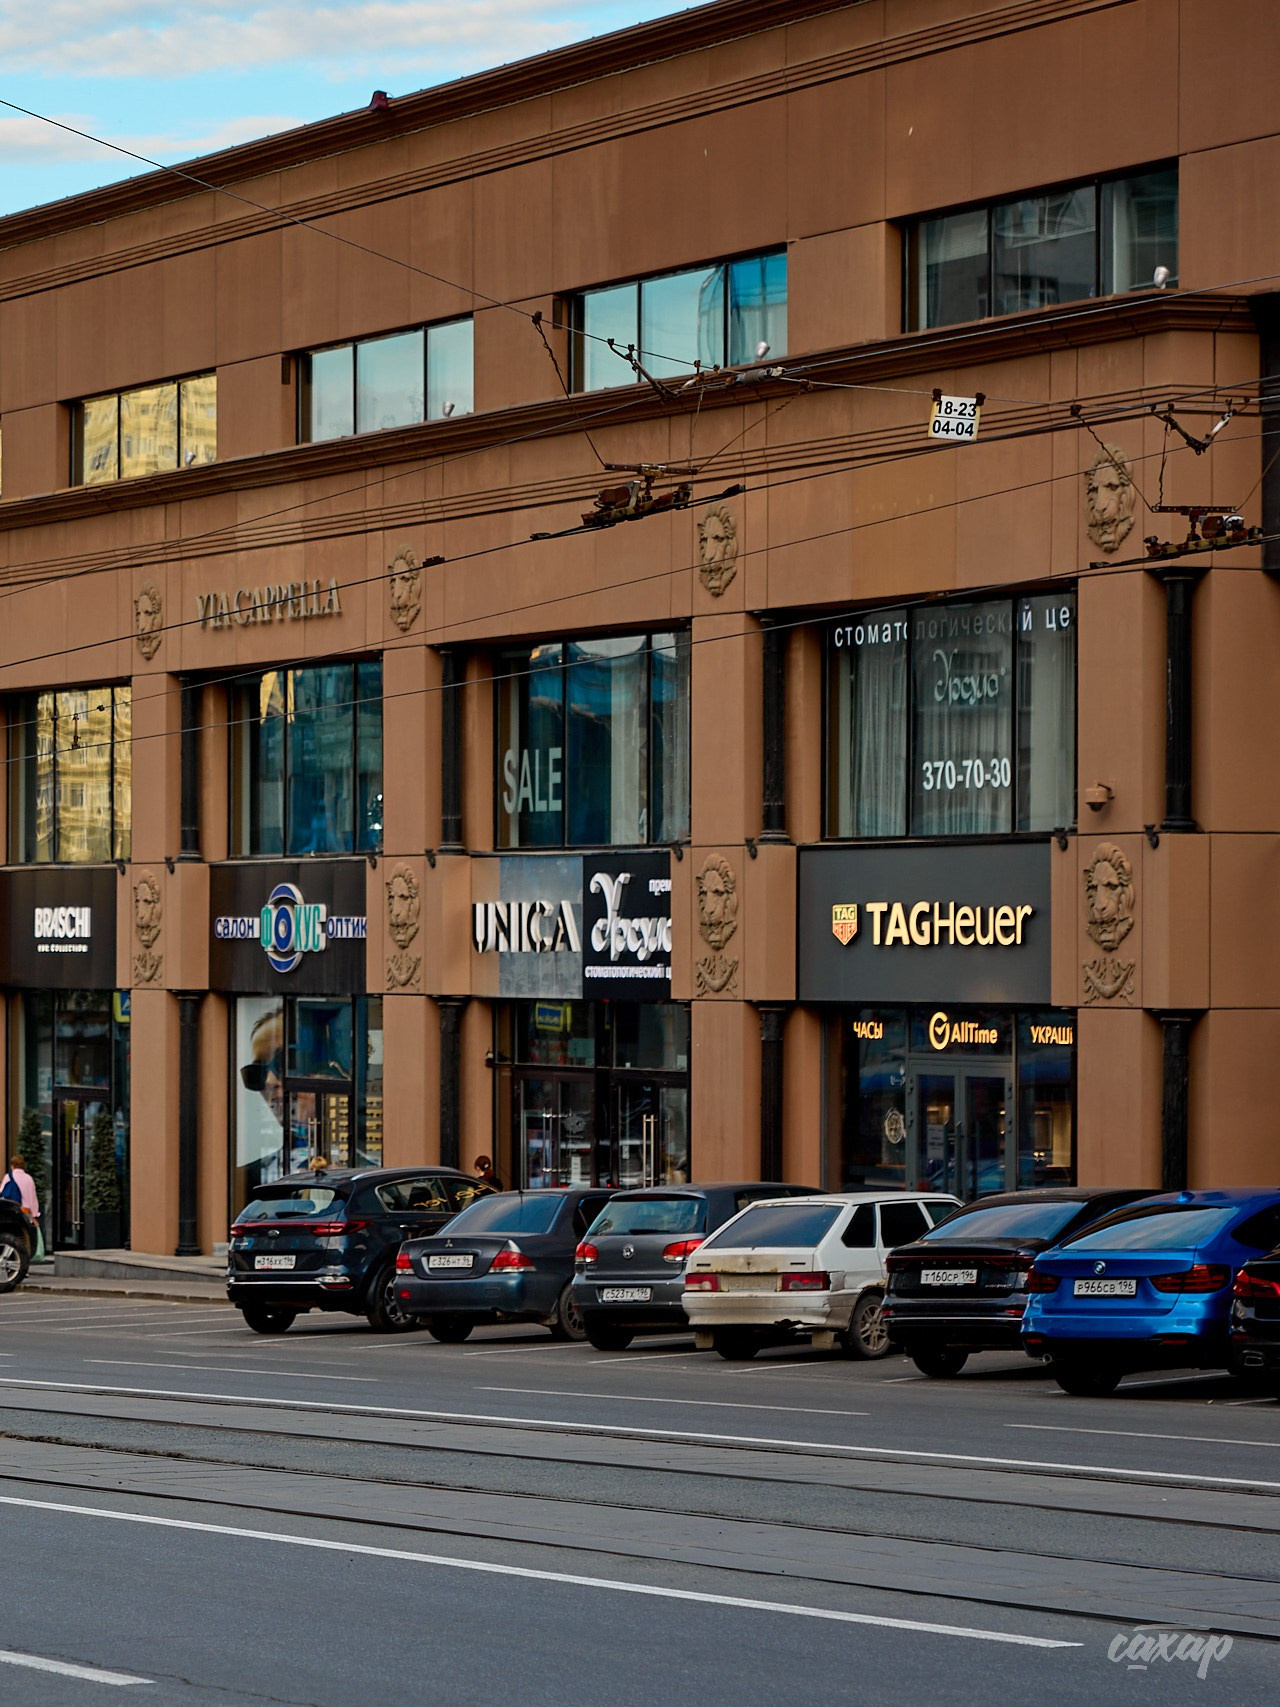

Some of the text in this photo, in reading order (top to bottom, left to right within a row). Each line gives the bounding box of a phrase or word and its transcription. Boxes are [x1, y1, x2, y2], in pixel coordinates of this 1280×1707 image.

[936, 400, 976, 417] 18-23
[932, 420, 974, 436] 04-04
[196, 577, 342, 630] VIA CAPPELLA
[503, 747, 562, 814] SALE
[923, 757, 1010, 790] 370-70-30
[34, 906, 91, 938] BRASCHI
[472, 900, 581, 954] UNICA
[835, 908, 855, 920] TAG
[853, 1021, 883, 1039] ЧАСЫ
[951, 1021, 998, 1045] AllTime
